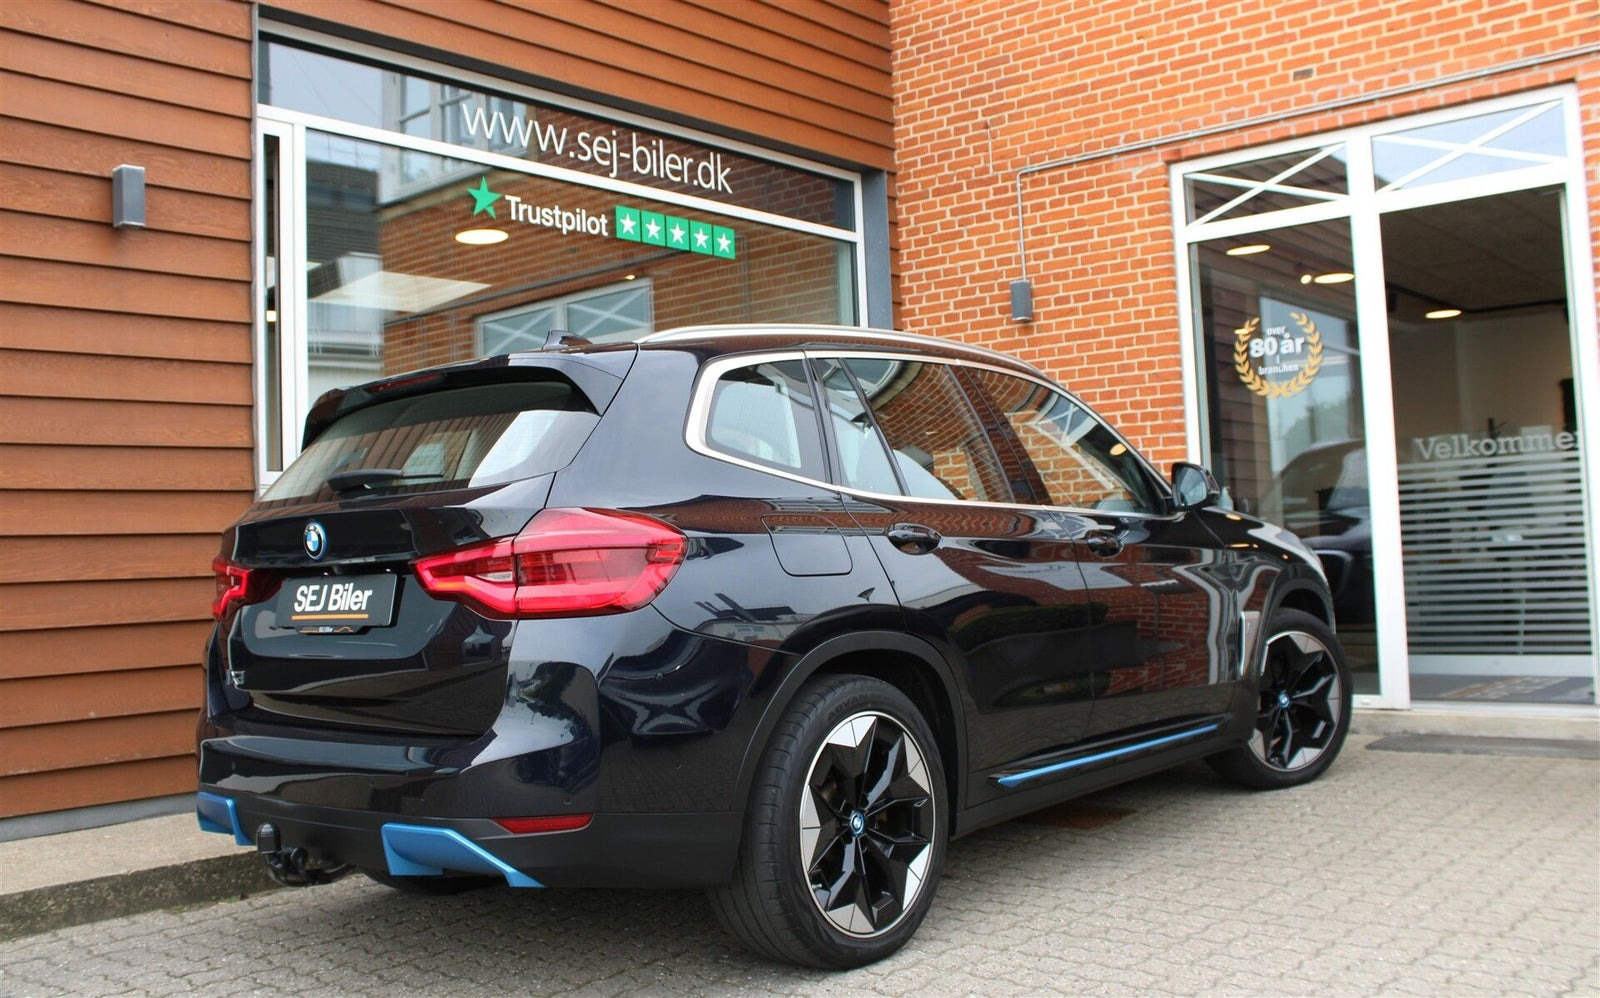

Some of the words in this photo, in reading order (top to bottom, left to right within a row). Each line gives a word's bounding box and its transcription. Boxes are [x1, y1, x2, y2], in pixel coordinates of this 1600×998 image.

[461, 103, 733, 194] www.sej-biler.dk
[504, 194, 609, 236] Trustpilot
[1250, 338, 1278, 358] 80
[1280, 333, 1304, 354] år
[1266, 326, 1285, 335] over
[294, 584, 329, 612] SEJ
[327, 582, 373, 611] Biler
